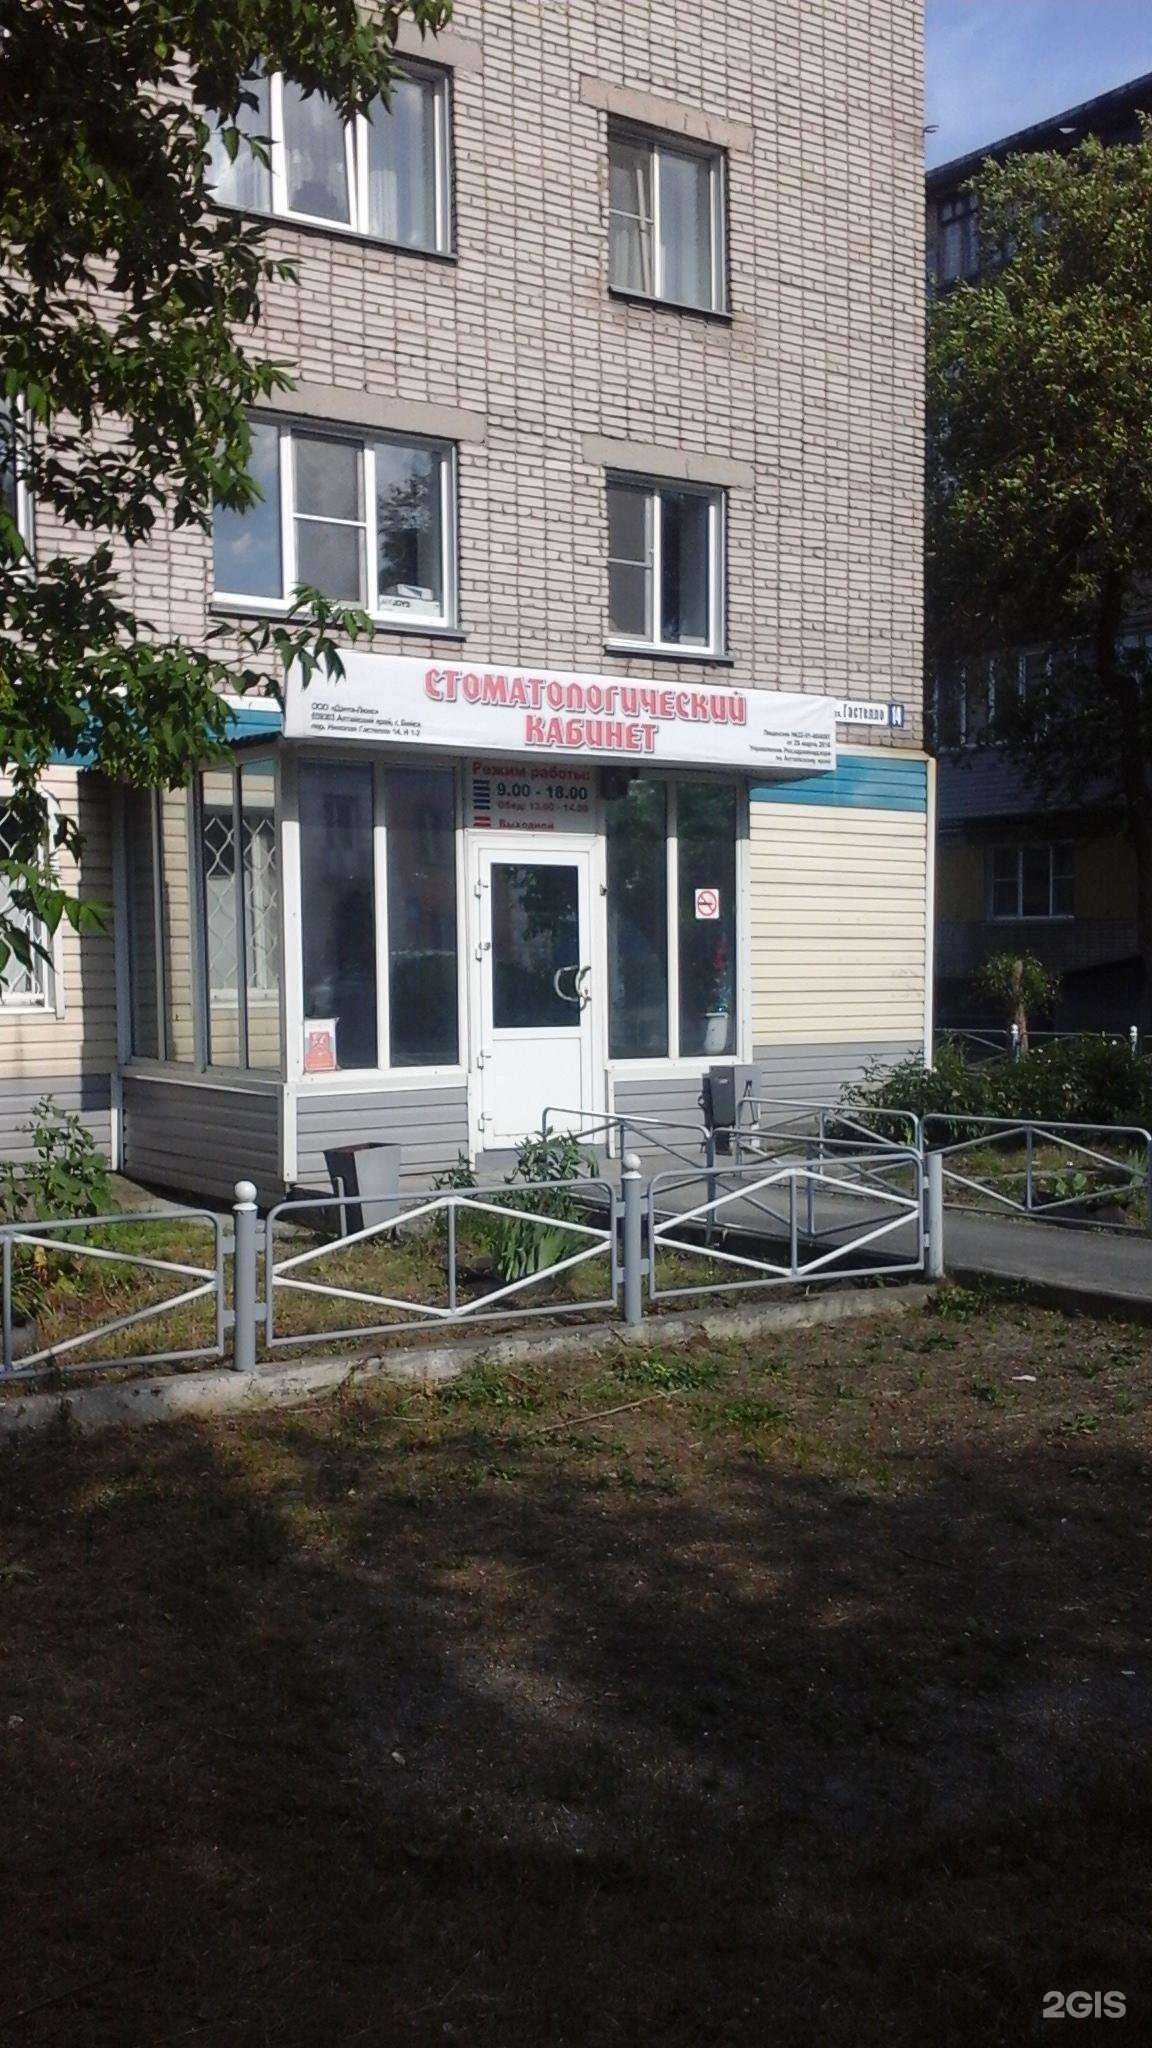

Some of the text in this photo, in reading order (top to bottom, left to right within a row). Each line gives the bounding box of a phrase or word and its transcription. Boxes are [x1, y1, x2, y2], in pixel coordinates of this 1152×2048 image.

[424, 668, 747, 725] СТОМАТОЛОГИЧЕСКИЙ
[524, 714, 659, 752] КАБИНЕТ
[472, 761, 591, 780] Режим работы:
[496, 782, 530, 798] 9.00
[547, 785, 588, 801] 18.00
